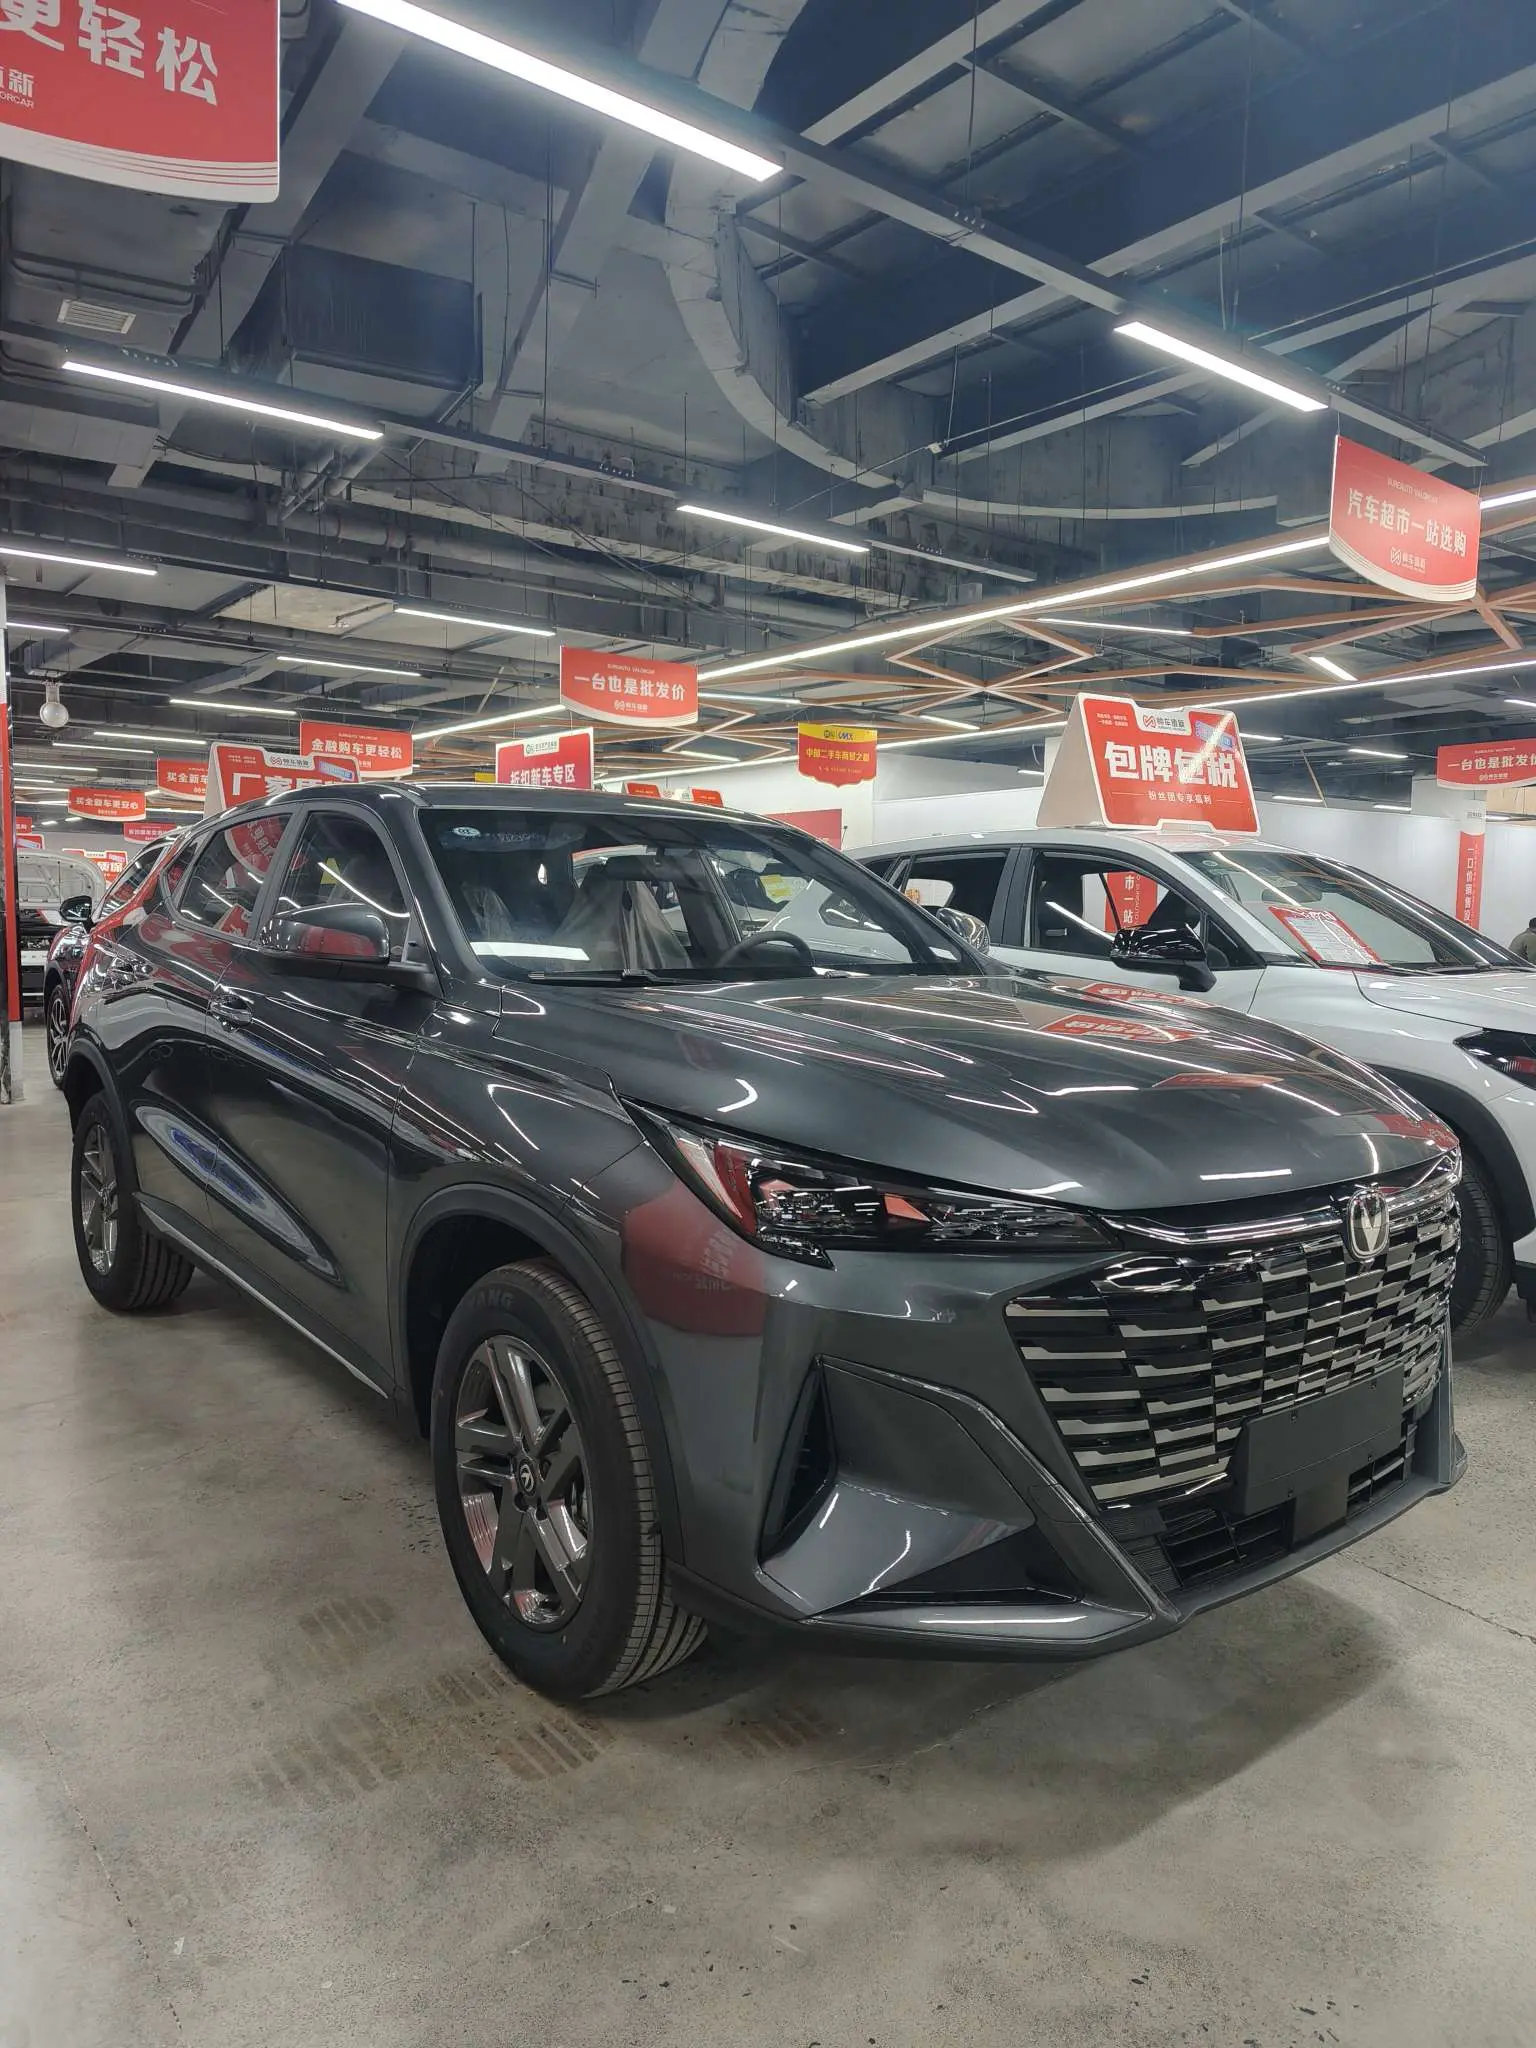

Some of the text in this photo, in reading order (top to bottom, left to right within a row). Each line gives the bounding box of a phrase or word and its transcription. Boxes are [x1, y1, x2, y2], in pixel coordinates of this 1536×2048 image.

[0, 0, 219, 107] 更轻松
[0, 66, 34, 98] 新
[1347, 487, 1467, 558] 汽车超市一站选购
[573, 672, 686, 701] 一台也是批发价
[311, 738, 403, 760] 金融购车更轻松
